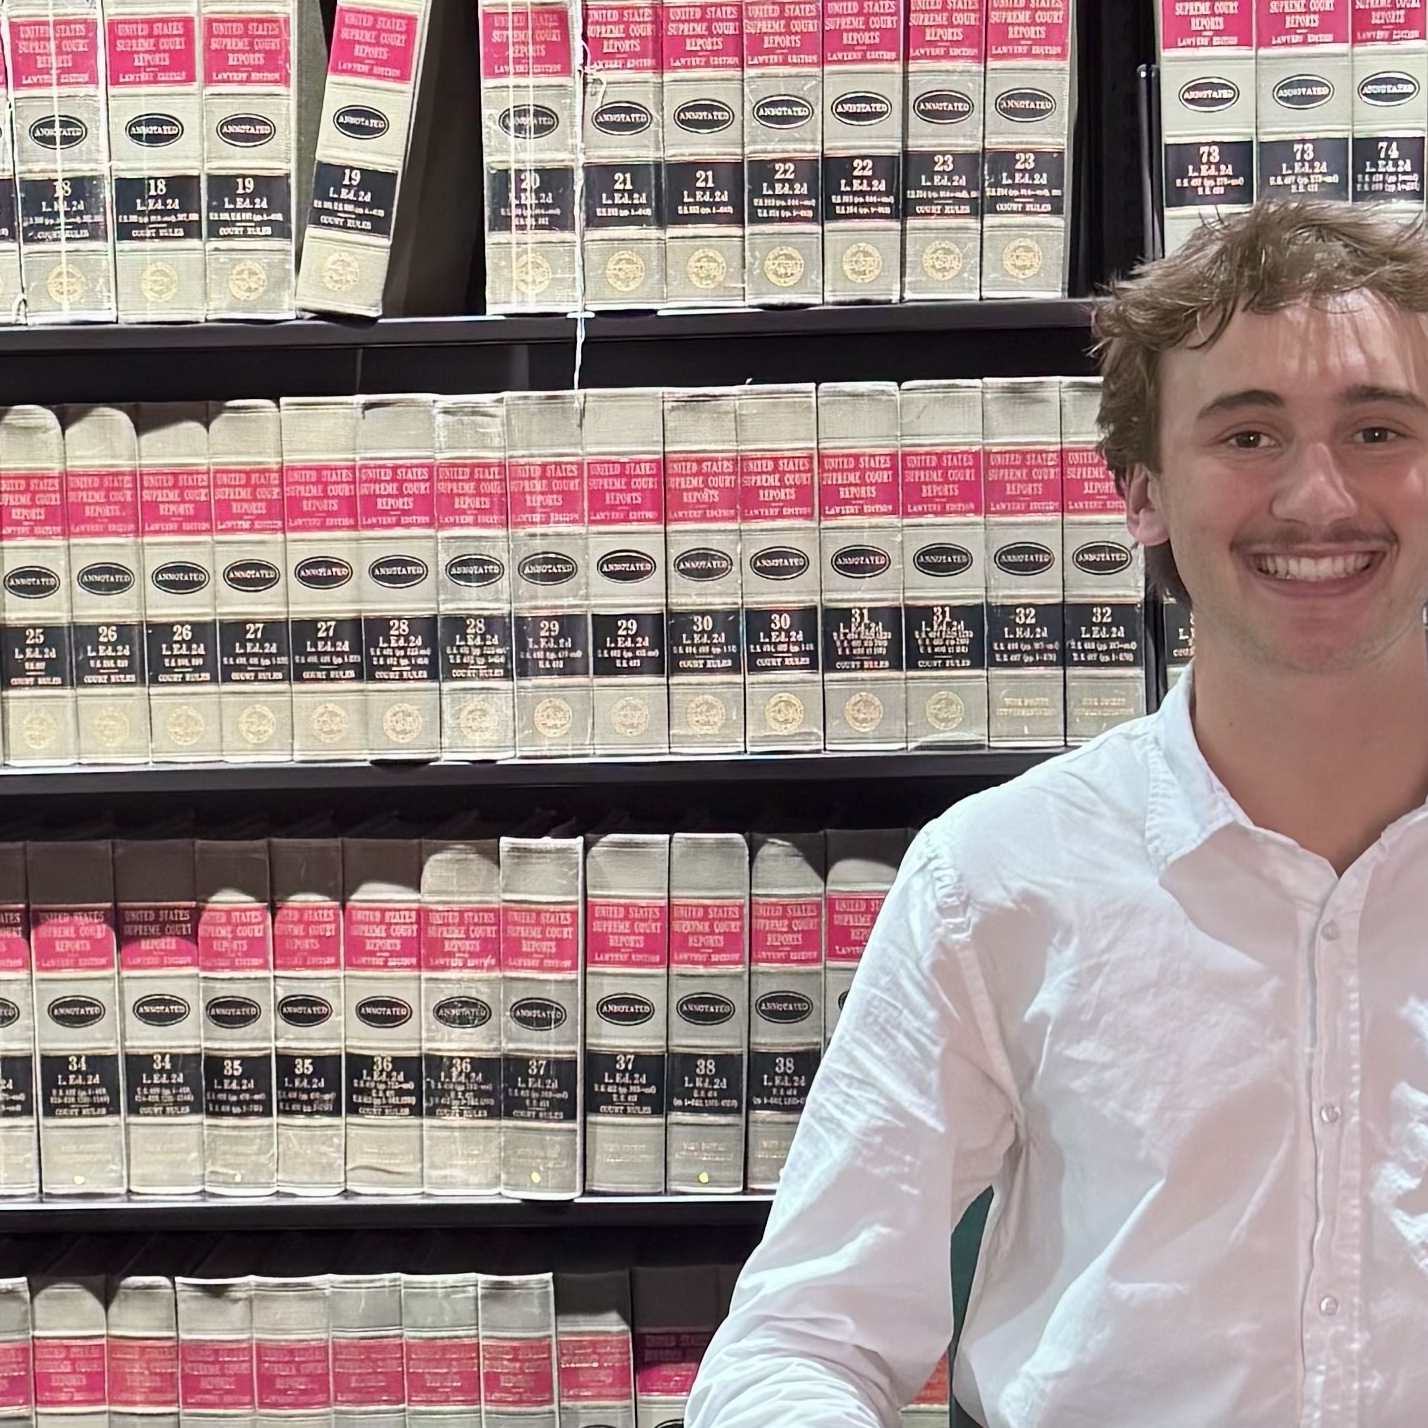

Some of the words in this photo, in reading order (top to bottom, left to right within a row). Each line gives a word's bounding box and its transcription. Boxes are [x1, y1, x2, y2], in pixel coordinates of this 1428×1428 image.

[990, 11, 1031, 24] SUPREME
[1035, 10, 1063, 24] COURT
[1008, 26, 1046, 39] REPORTS
[1015, 152, 1035, 170] 23
[1199, 145, 1220, 164] 73
[774, 162, 795, 180] 22
[236, 177, 255, 194] 19
[396, 467, 430, 480] STATES
[377, 498, 414, 511] REPORTS
[389, 619, 409, 636] 28
[770, 612, 791, 630] 30
[98, 625, 118, 643] 26
[294, 1058, 314, 1075] 35
[695, 1058, 716, 1075] 38
